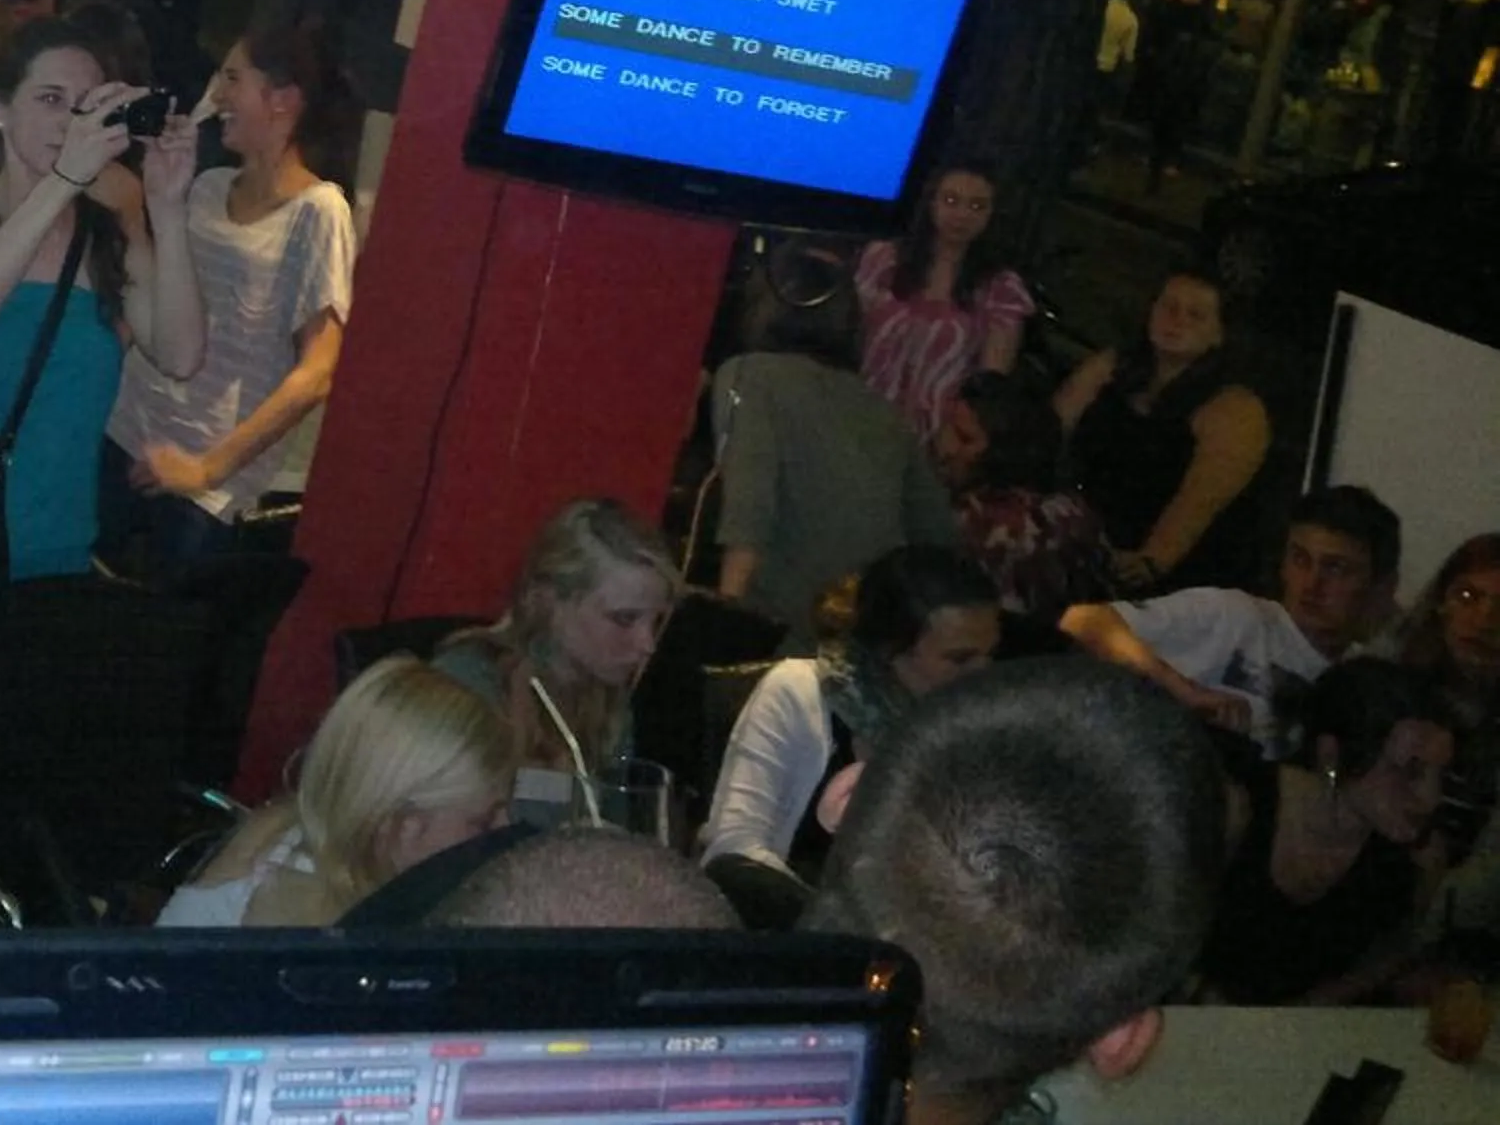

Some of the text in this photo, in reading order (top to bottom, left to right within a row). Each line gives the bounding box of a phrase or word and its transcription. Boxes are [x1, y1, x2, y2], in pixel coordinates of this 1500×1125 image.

[558, 3, 893, 80] SOME DANCE TO REMEMBER
[541, 56, 848, 123] SOME DANCE TO FORGET
